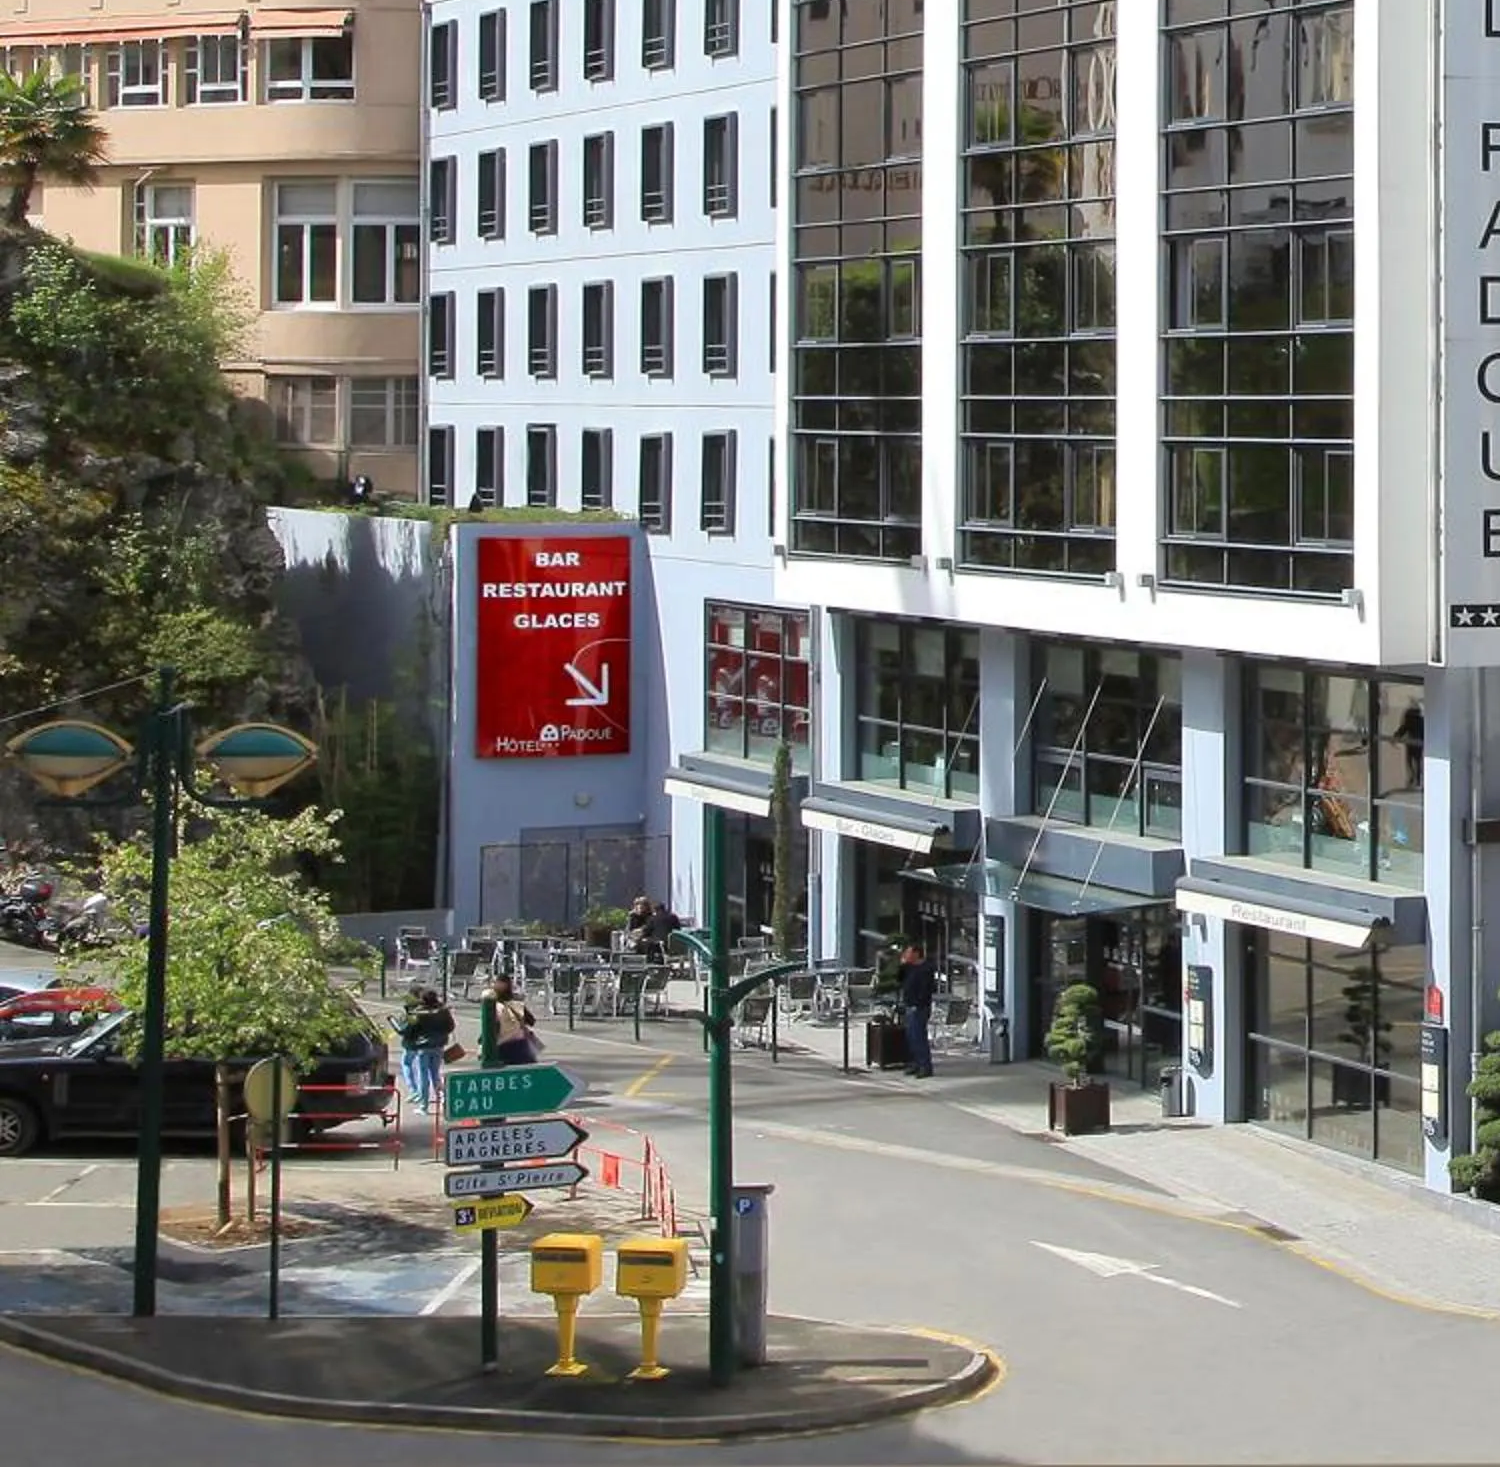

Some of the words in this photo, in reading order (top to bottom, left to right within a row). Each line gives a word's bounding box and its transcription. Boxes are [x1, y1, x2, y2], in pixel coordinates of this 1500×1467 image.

[535, 552, 580, 567] BAR
[483, 581, 627, 598] RESTAURANT
[513, 612, 600, 628] GLACES
[560, 724, 612, 741] PADOUE
[1231, 903, 1307, 932] Restaurant
[454, 1074, 533, 1094] TARBES
[454, 1096, 494, 1113] PAU
[516, 1171, 566, 1185] Pierre
[739, 1199, 751, 1212] P
